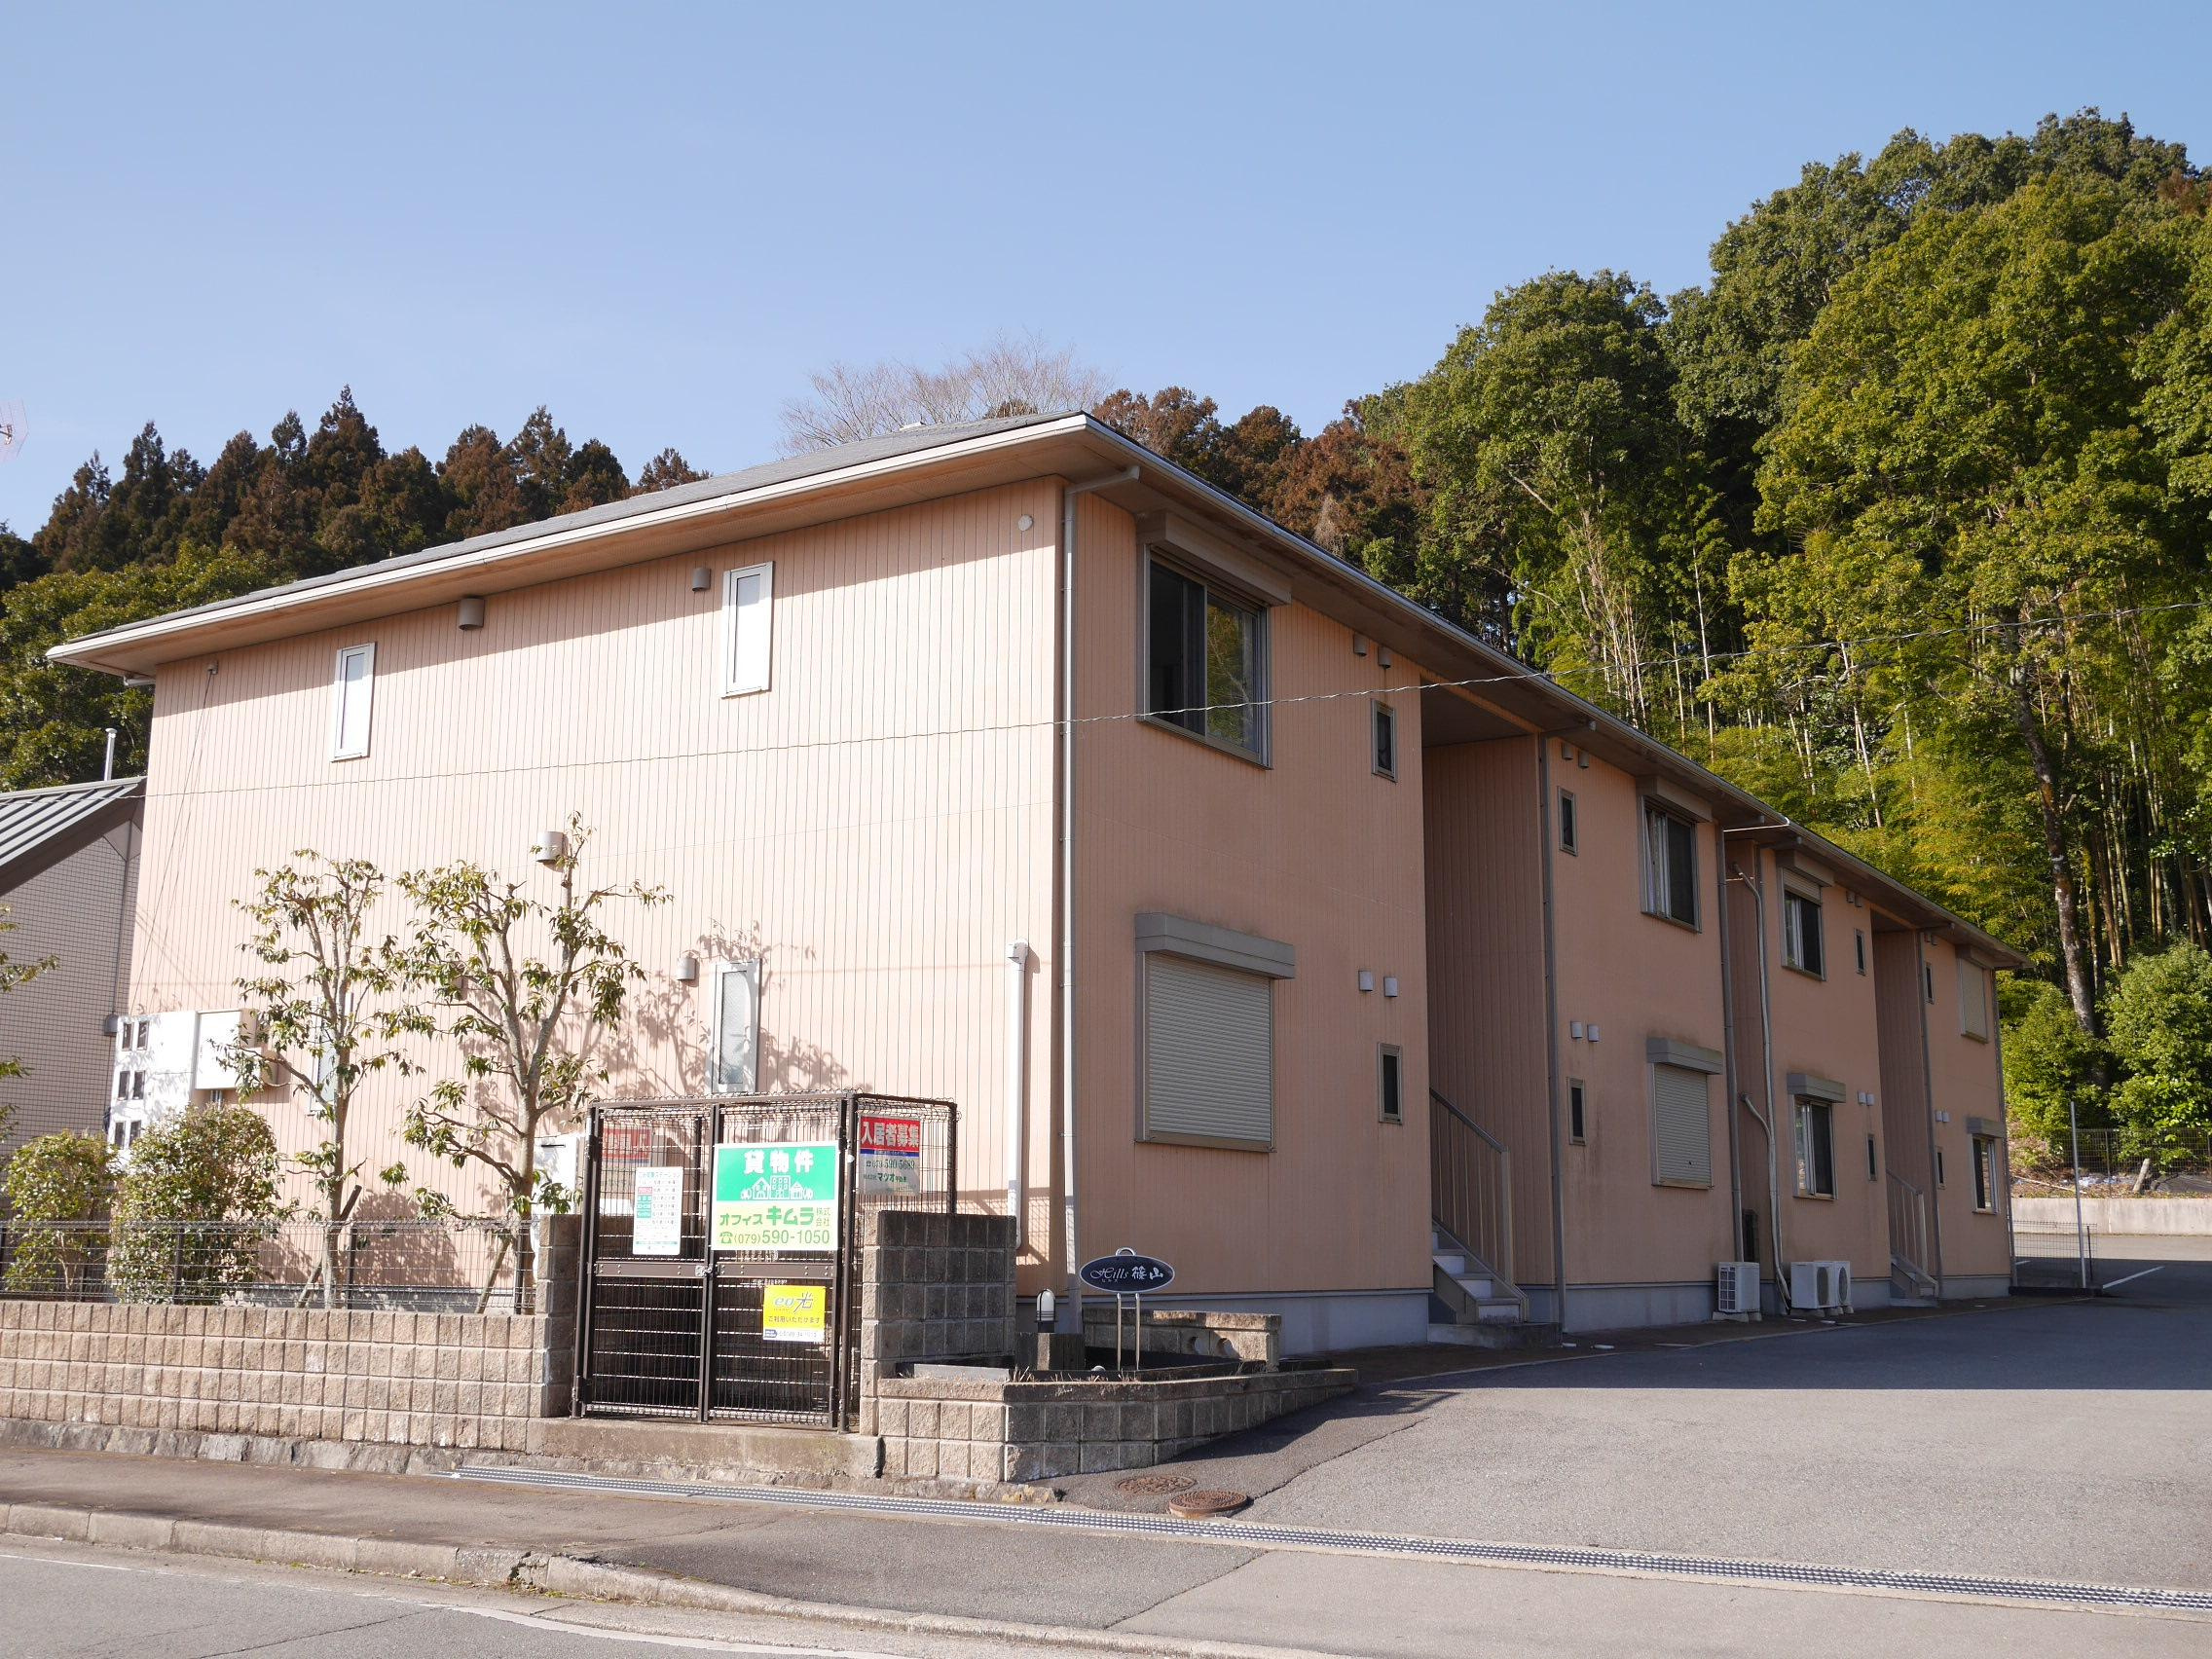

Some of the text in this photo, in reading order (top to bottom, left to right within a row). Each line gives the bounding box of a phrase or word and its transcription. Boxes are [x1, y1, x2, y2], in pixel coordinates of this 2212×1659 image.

[862, 1122, 919, 1148] 入居者募集
[1090, 1266, 1164, 1280] Hills 篠山
